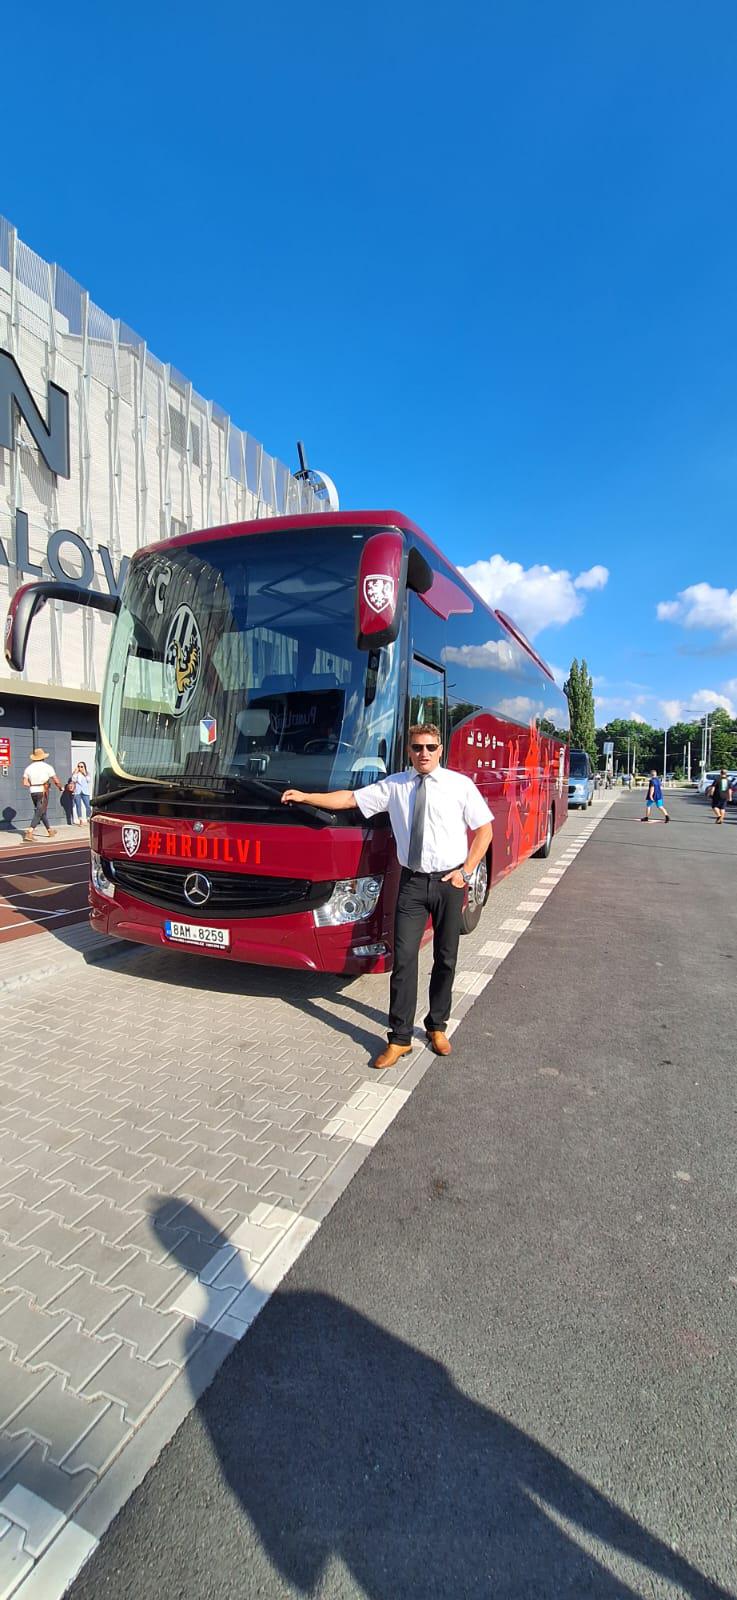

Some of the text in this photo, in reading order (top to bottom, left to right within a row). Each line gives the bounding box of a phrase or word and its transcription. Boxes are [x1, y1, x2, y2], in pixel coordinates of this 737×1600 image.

[147, 831, 261, 865] #HRDILVI
[173, 924, 224, 943] 8AM 8259
